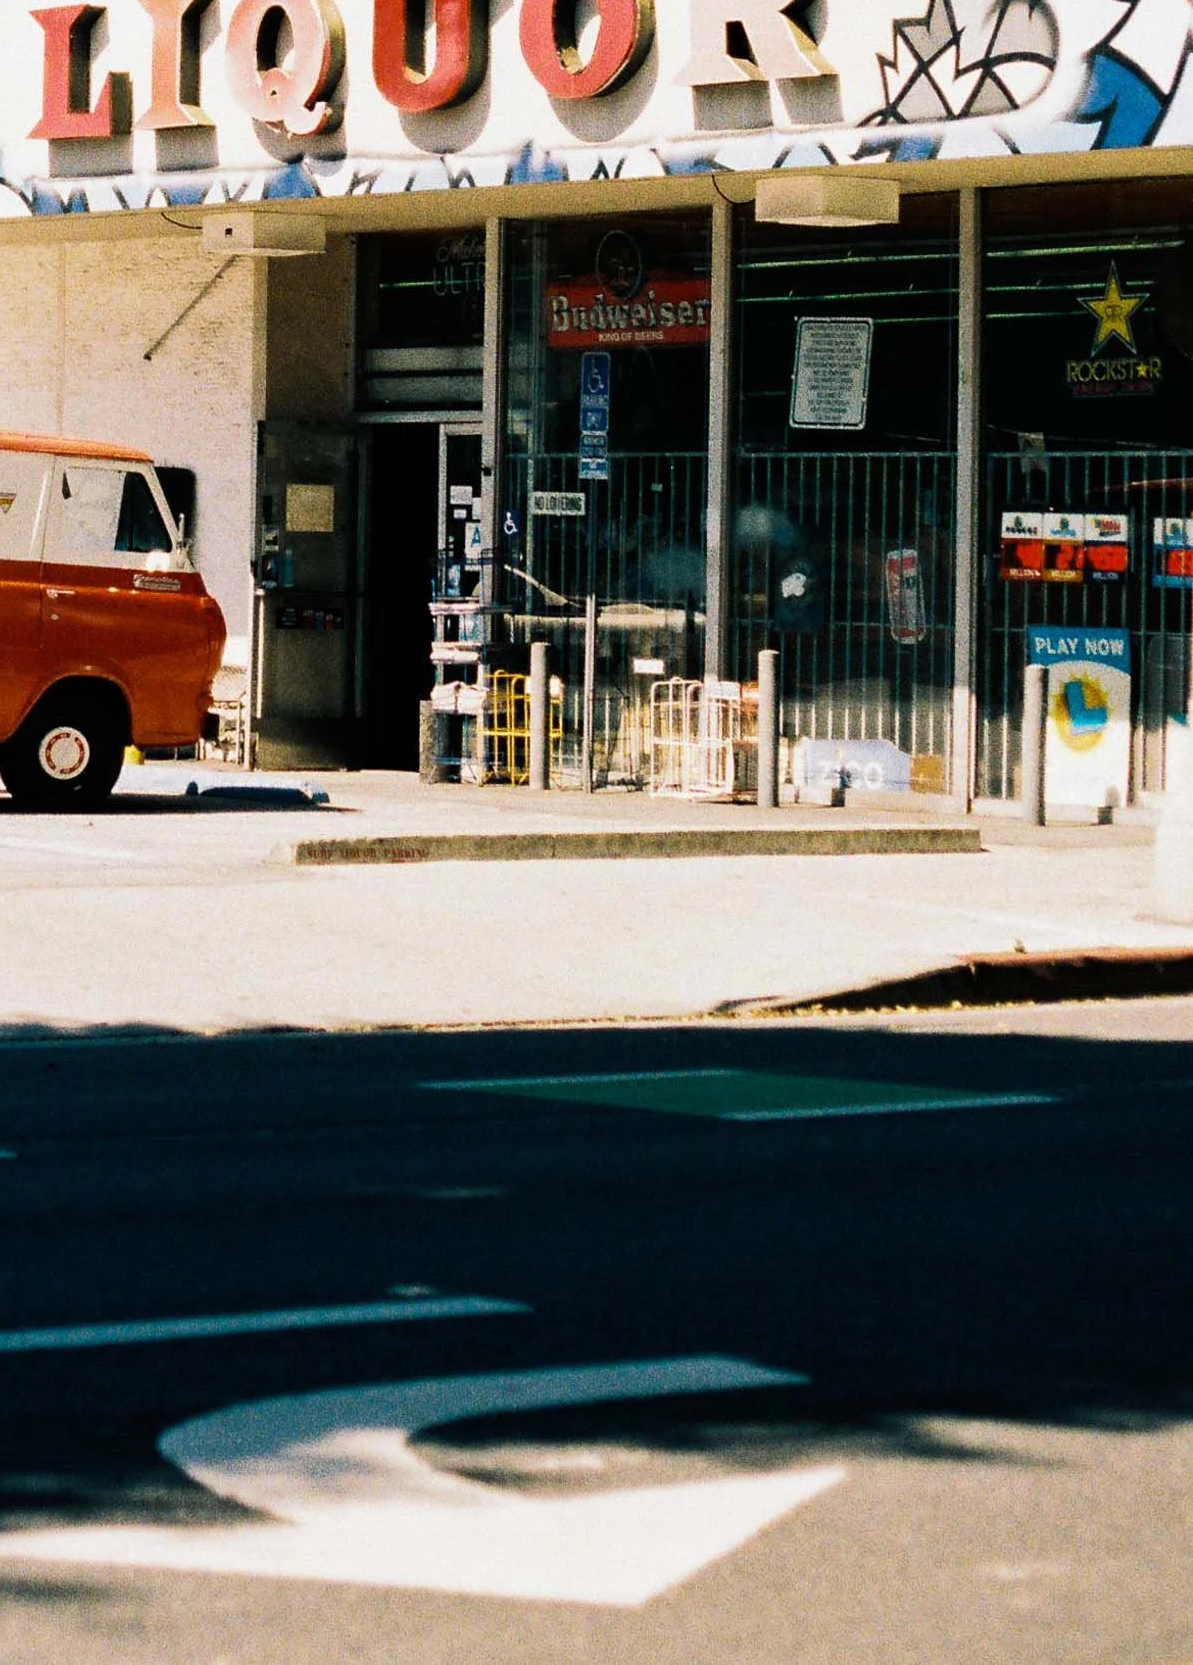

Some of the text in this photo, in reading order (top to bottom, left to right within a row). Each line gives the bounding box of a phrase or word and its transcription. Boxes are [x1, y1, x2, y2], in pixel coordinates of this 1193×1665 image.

[551, 289, 710, 332] Budweiser
[1034, 637, 1125, 656] PLAY NOW
